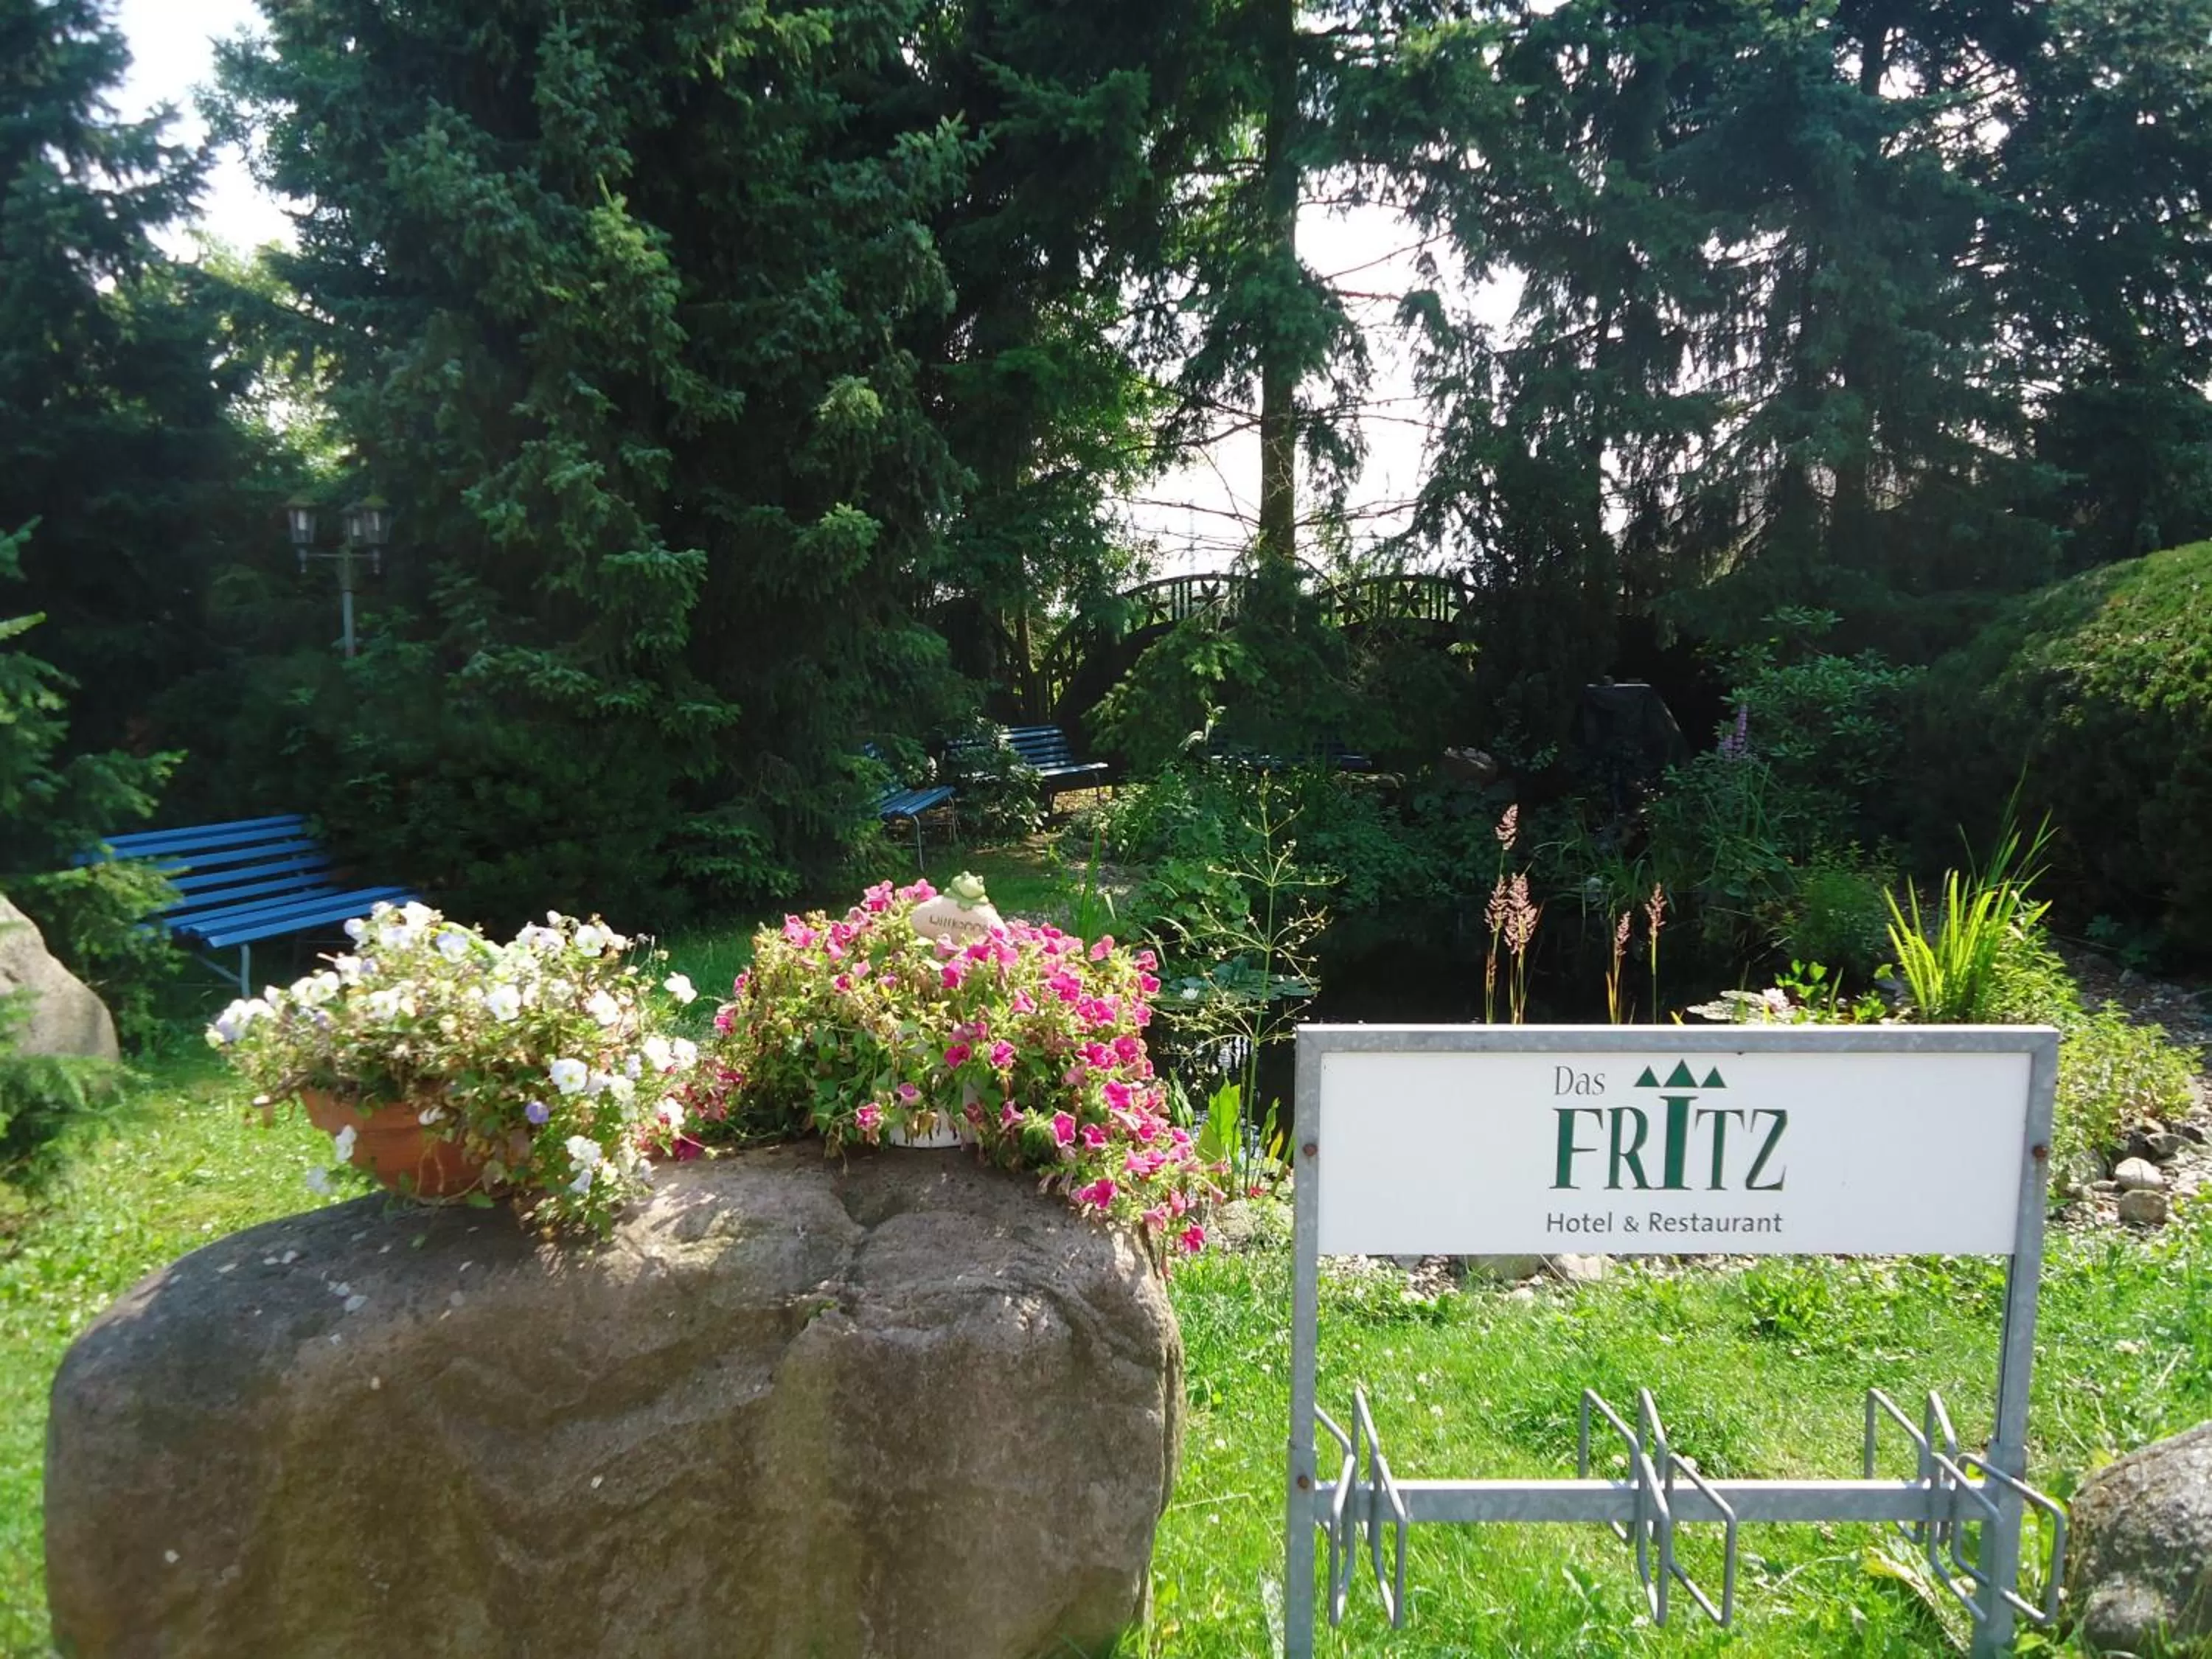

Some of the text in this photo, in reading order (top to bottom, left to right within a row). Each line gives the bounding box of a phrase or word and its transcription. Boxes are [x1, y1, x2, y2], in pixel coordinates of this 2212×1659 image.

[1555, 1065, 1605, 1096] Das
[1548, 1095, 1788, 1191] FRITZ
[1546, 1211, 1783, 1233] Hotel & Restaurant
